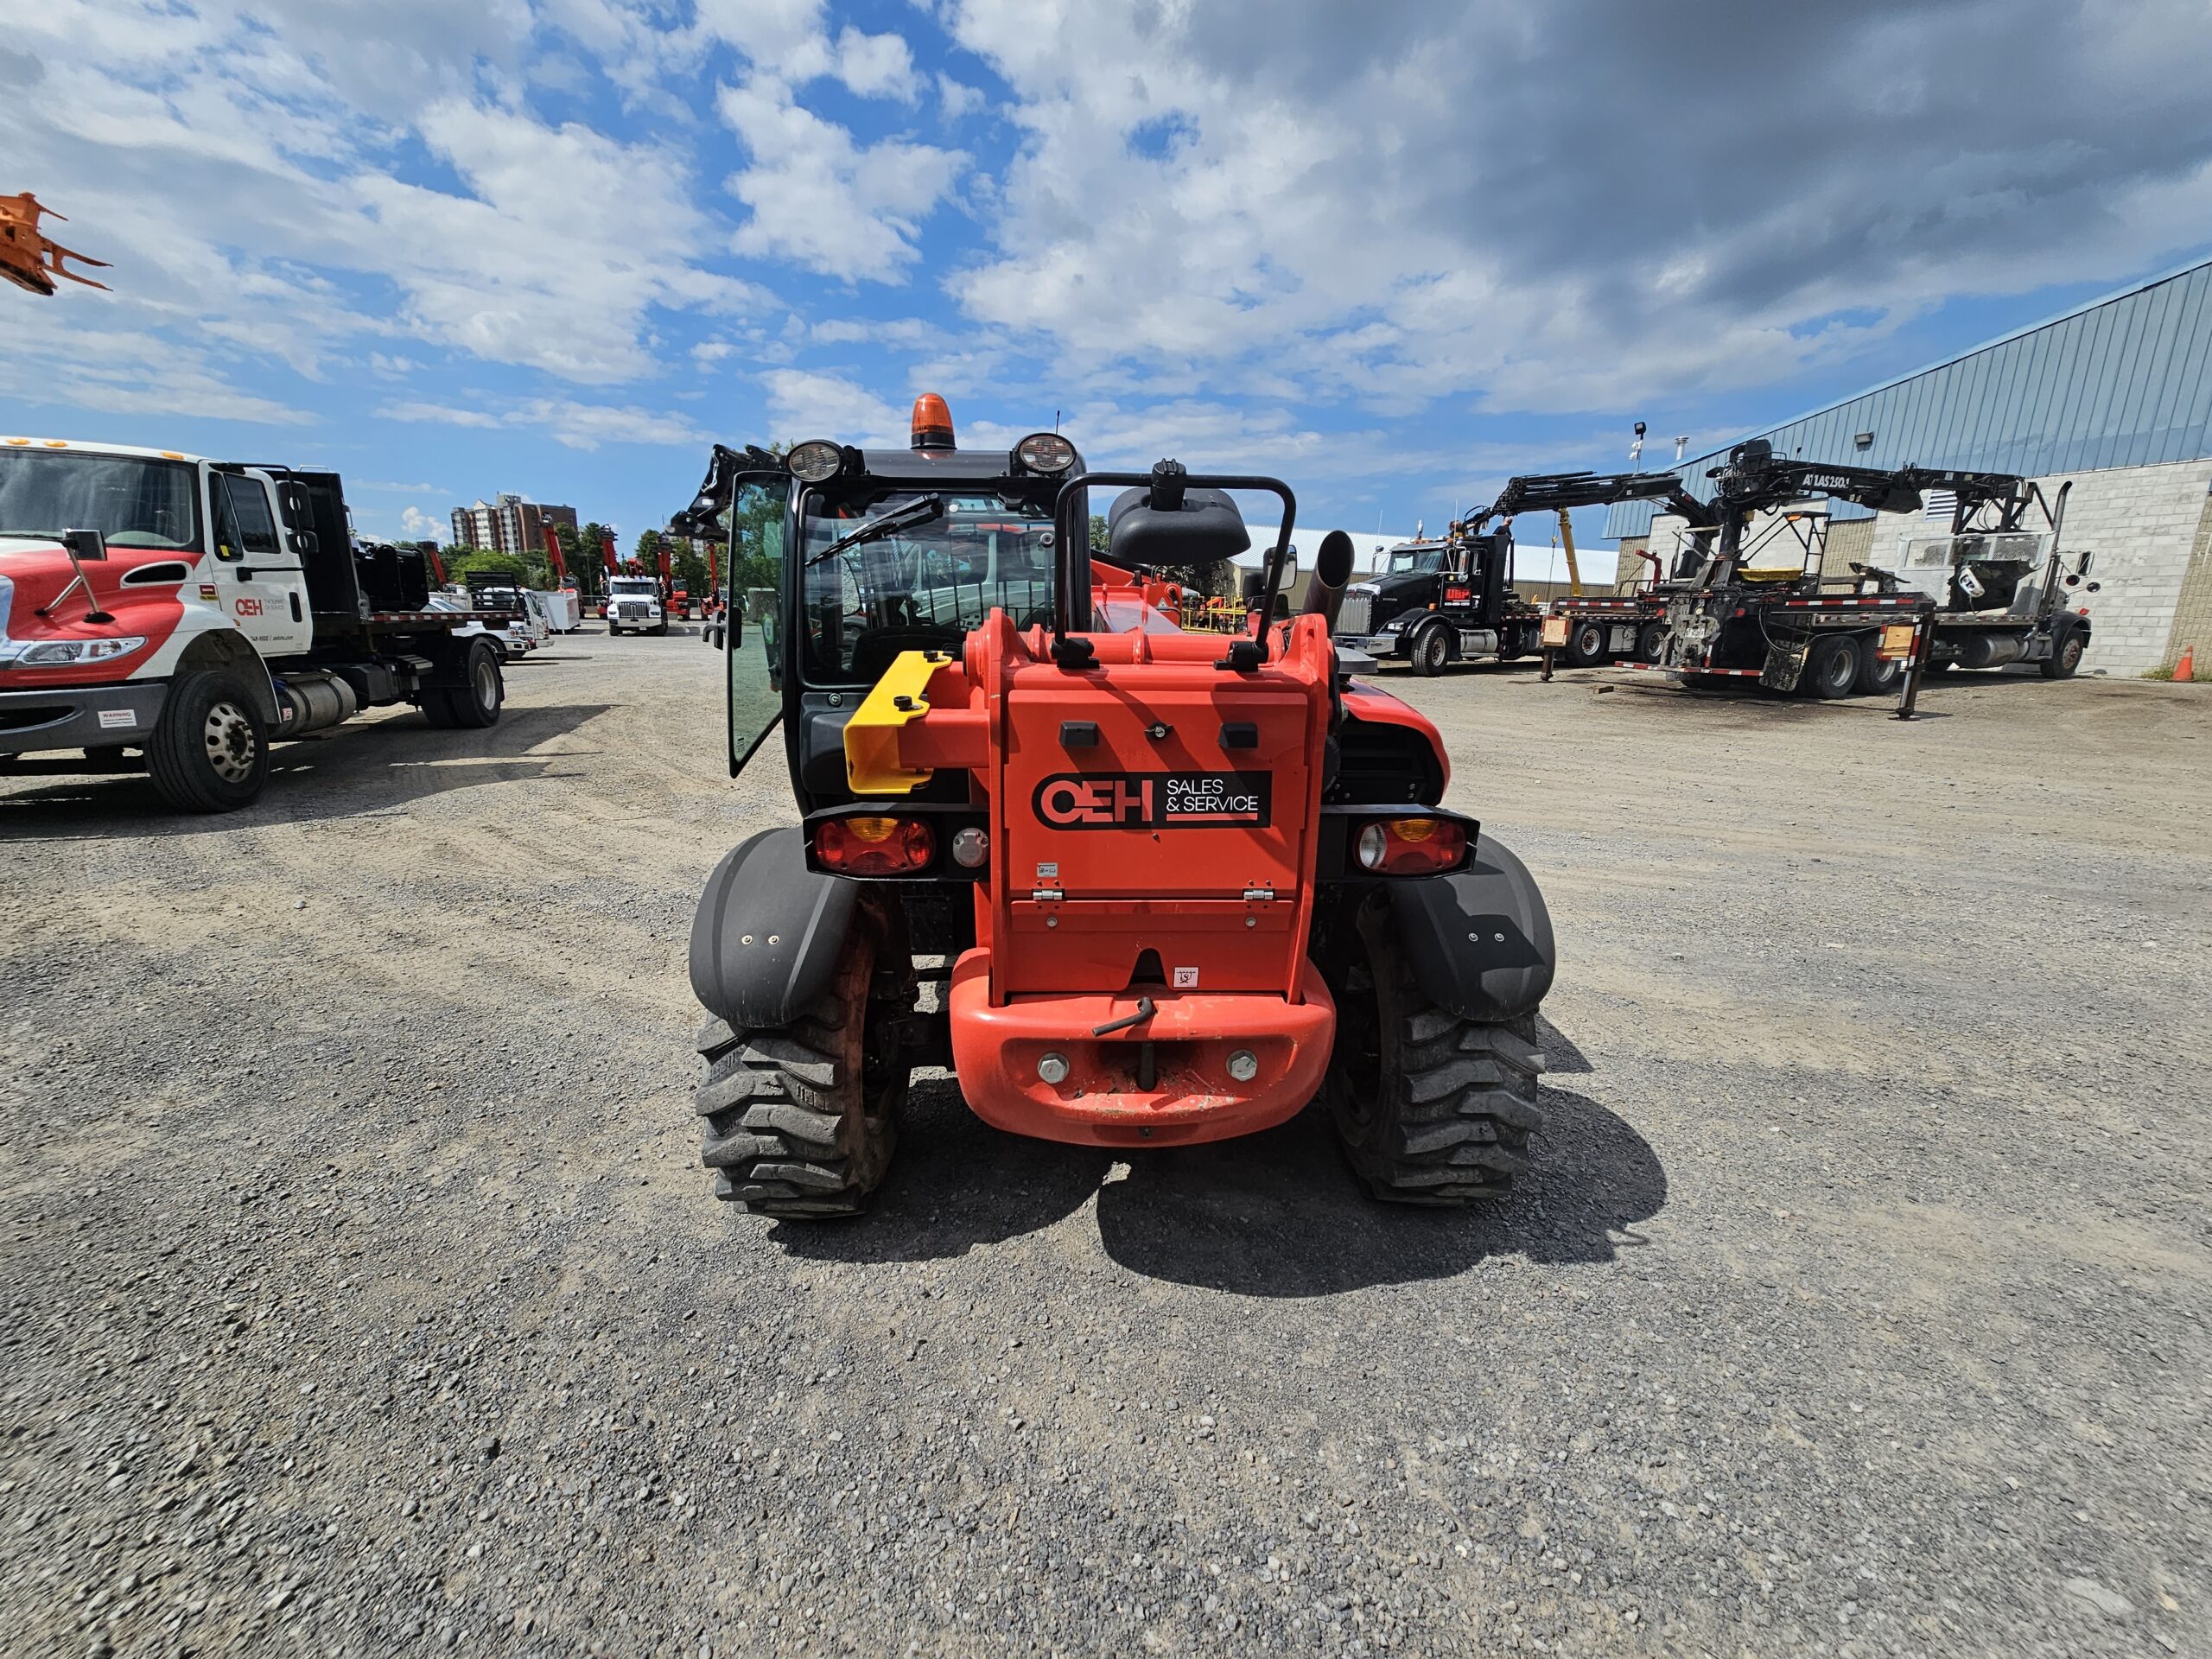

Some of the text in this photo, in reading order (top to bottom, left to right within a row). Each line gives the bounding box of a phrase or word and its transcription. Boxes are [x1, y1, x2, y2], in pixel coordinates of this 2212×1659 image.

[1446, 588, 1470, 600] UBP
[235, 598, 263, 615] OEH
[1040, 779, 1224, 823] OEH SALES
[1166, 796, 1259, 812] & SERVICE
